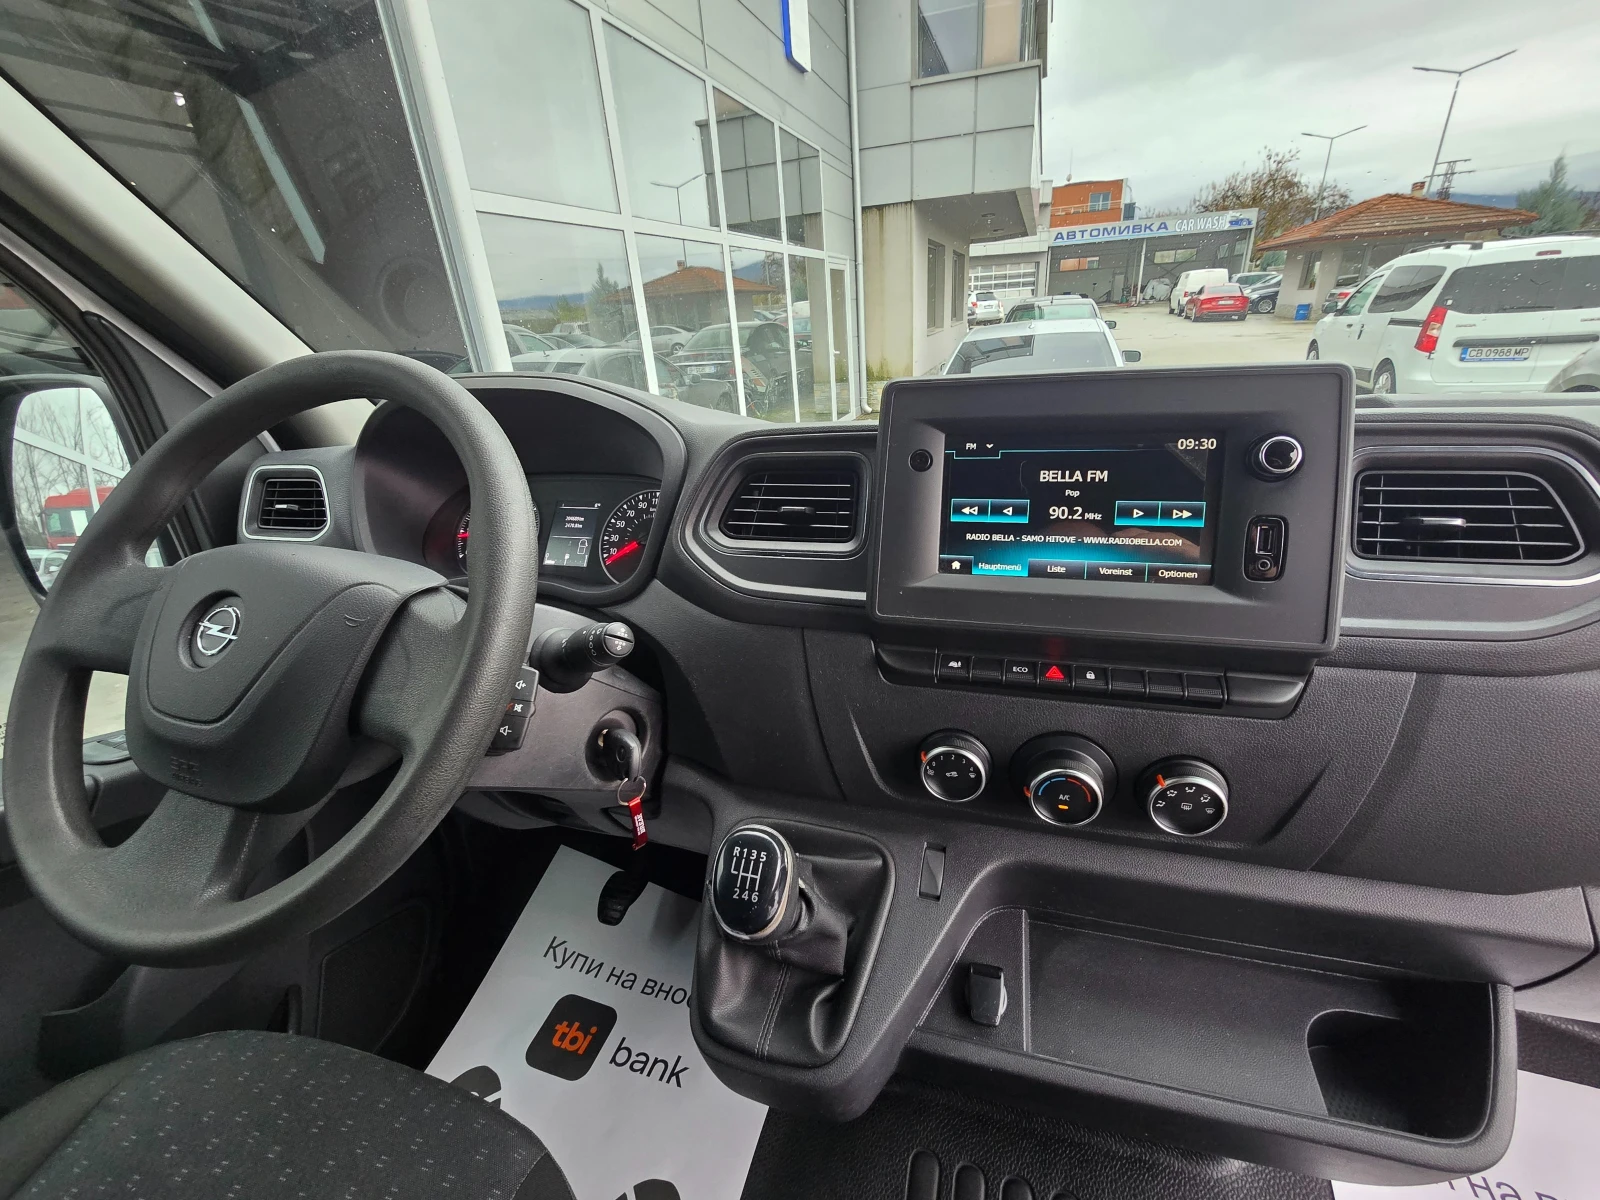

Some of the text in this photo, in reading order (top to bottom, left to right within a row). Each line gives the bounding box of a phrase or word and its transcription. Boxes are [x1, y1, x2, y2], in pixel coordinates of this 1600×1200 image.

[1175, 215, 1227, 232] CAR WASH
[1053, 221, 1169, 242] АВТОМИВКА
[1468, 348, 1483, 358] CB
[1513, 347, 1529, 357] MP
[1177, 438, 1217, 450] 09:30
[1039, 470, 1108, 483] BELLA FM
[1065, 489, 1080, 498] Pop
[1049, 506, 1102, 521] 90.2 MHz
[616, 520, 625, 528] 50
[609, 534, 619, 542] 30
[966, 533, 990, 541] RADIO
[992, 534, 1015, 542] BELLA
[1021, 535, 1044, 543] SAMO
[1045, 535, 1077, 544] HITOVE
[1083, 536, 1182, 547] WWW.RADIOBELLA.COM
[978, 562, 1022, 573] Hauptmenü
[1047, 565, 1066, 573] Liste
[1099, 567, 1133, 577] Voreinst
[1158, 569, 1198, 579] Optionen
[1058, 793, 1070, 801] A/C
[733, 846, 767, 862] R 1 3 5
[732, 888, 759, 903] 2 4 6
[543, 935, 604, 979] Купи
[606, 966, 638, 991] на
[552, 1020, 690, 1089] tbi bank
